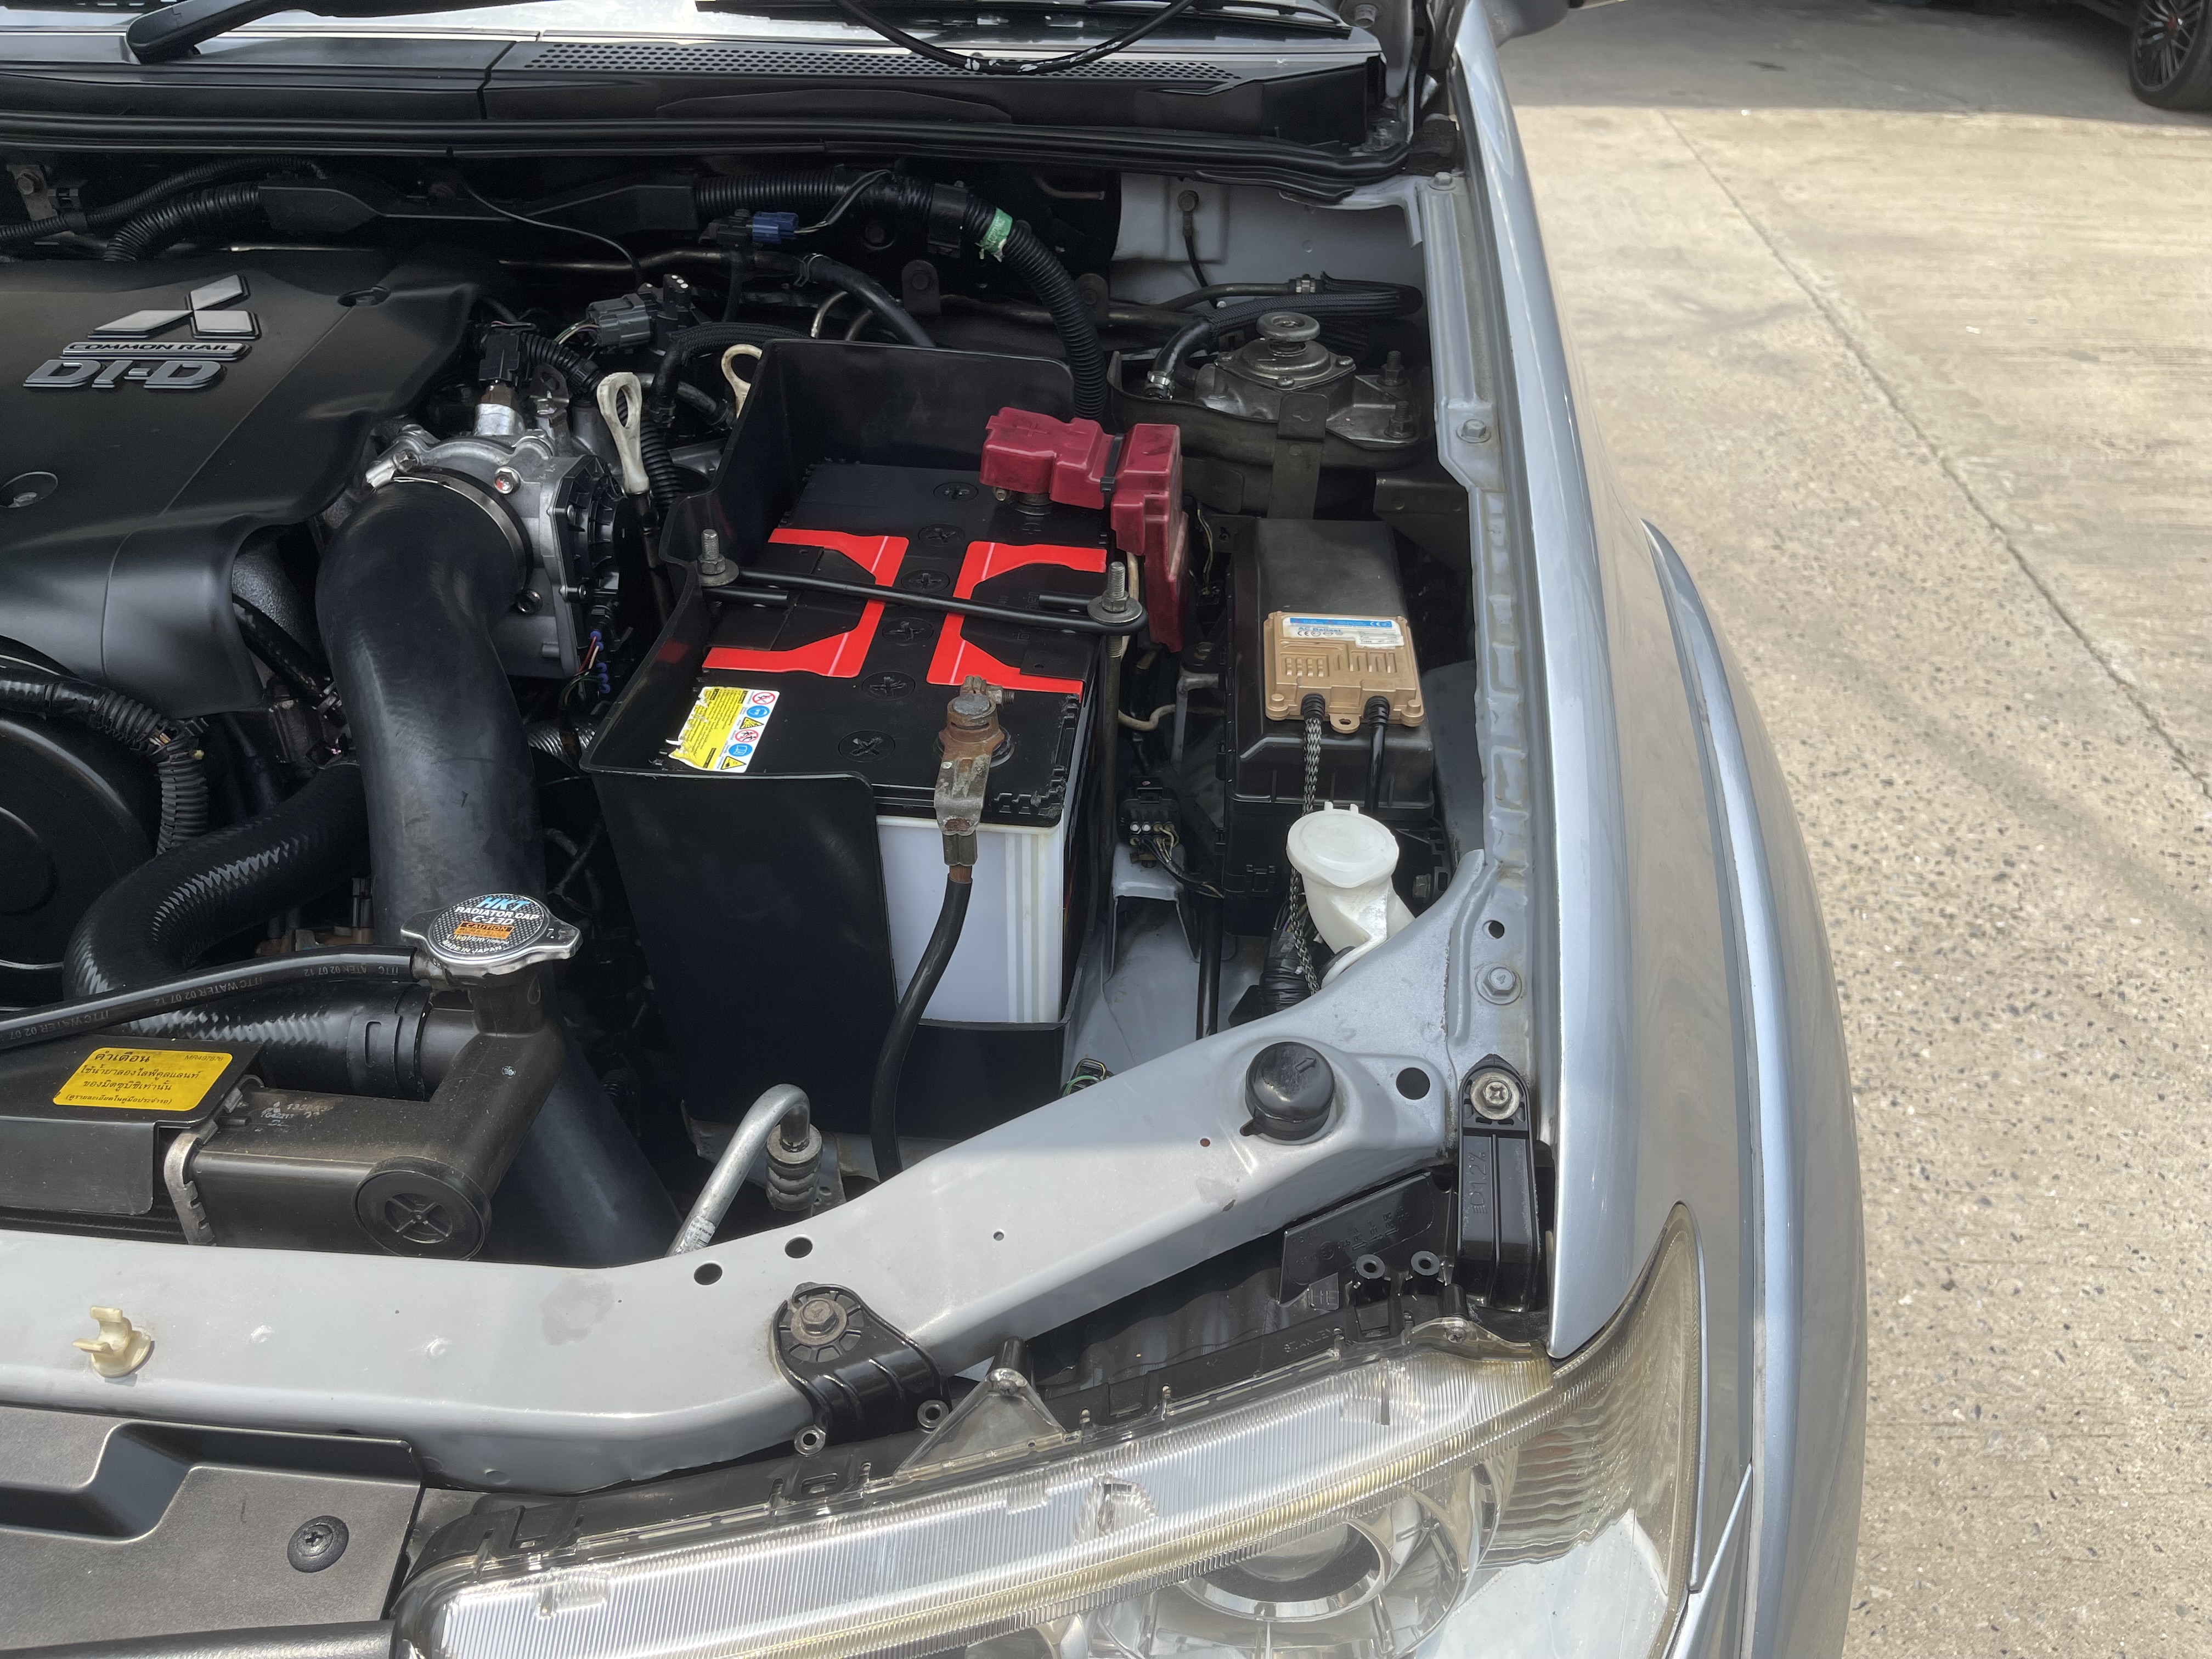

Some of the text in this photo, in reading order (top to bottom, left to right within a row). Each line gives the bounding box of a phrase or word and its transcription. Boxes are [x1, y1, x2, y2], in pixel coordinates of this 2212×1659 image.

[68, 343, 236, 353] COMMON RAIL
[22, 359, 226, 390] DI-D
[476, 897, 530, 911] HKT
[455, 906, 540, 921] RADIATOR CAP
[472, 915, 515, 926] C-13D
[466, 923, 508, 932] CAUTION
[441, 940, 460, 952] MADE
[472, 945, 503, 953] JAPAN
[318, 966, 329, 975] 07
[330, 966, 341, 974] 02
[198, 981, 239, 997] WATER
[171, 994, 182, 1003] 07
[185, 990, 197, 1000] 02
[39, 1017, 82, 1033] WATER
[10, 1030, 22, 1040] 07
[25, 1026, 37, 1036] 02
[95, 1050, 151, 1063] คำเตือน
